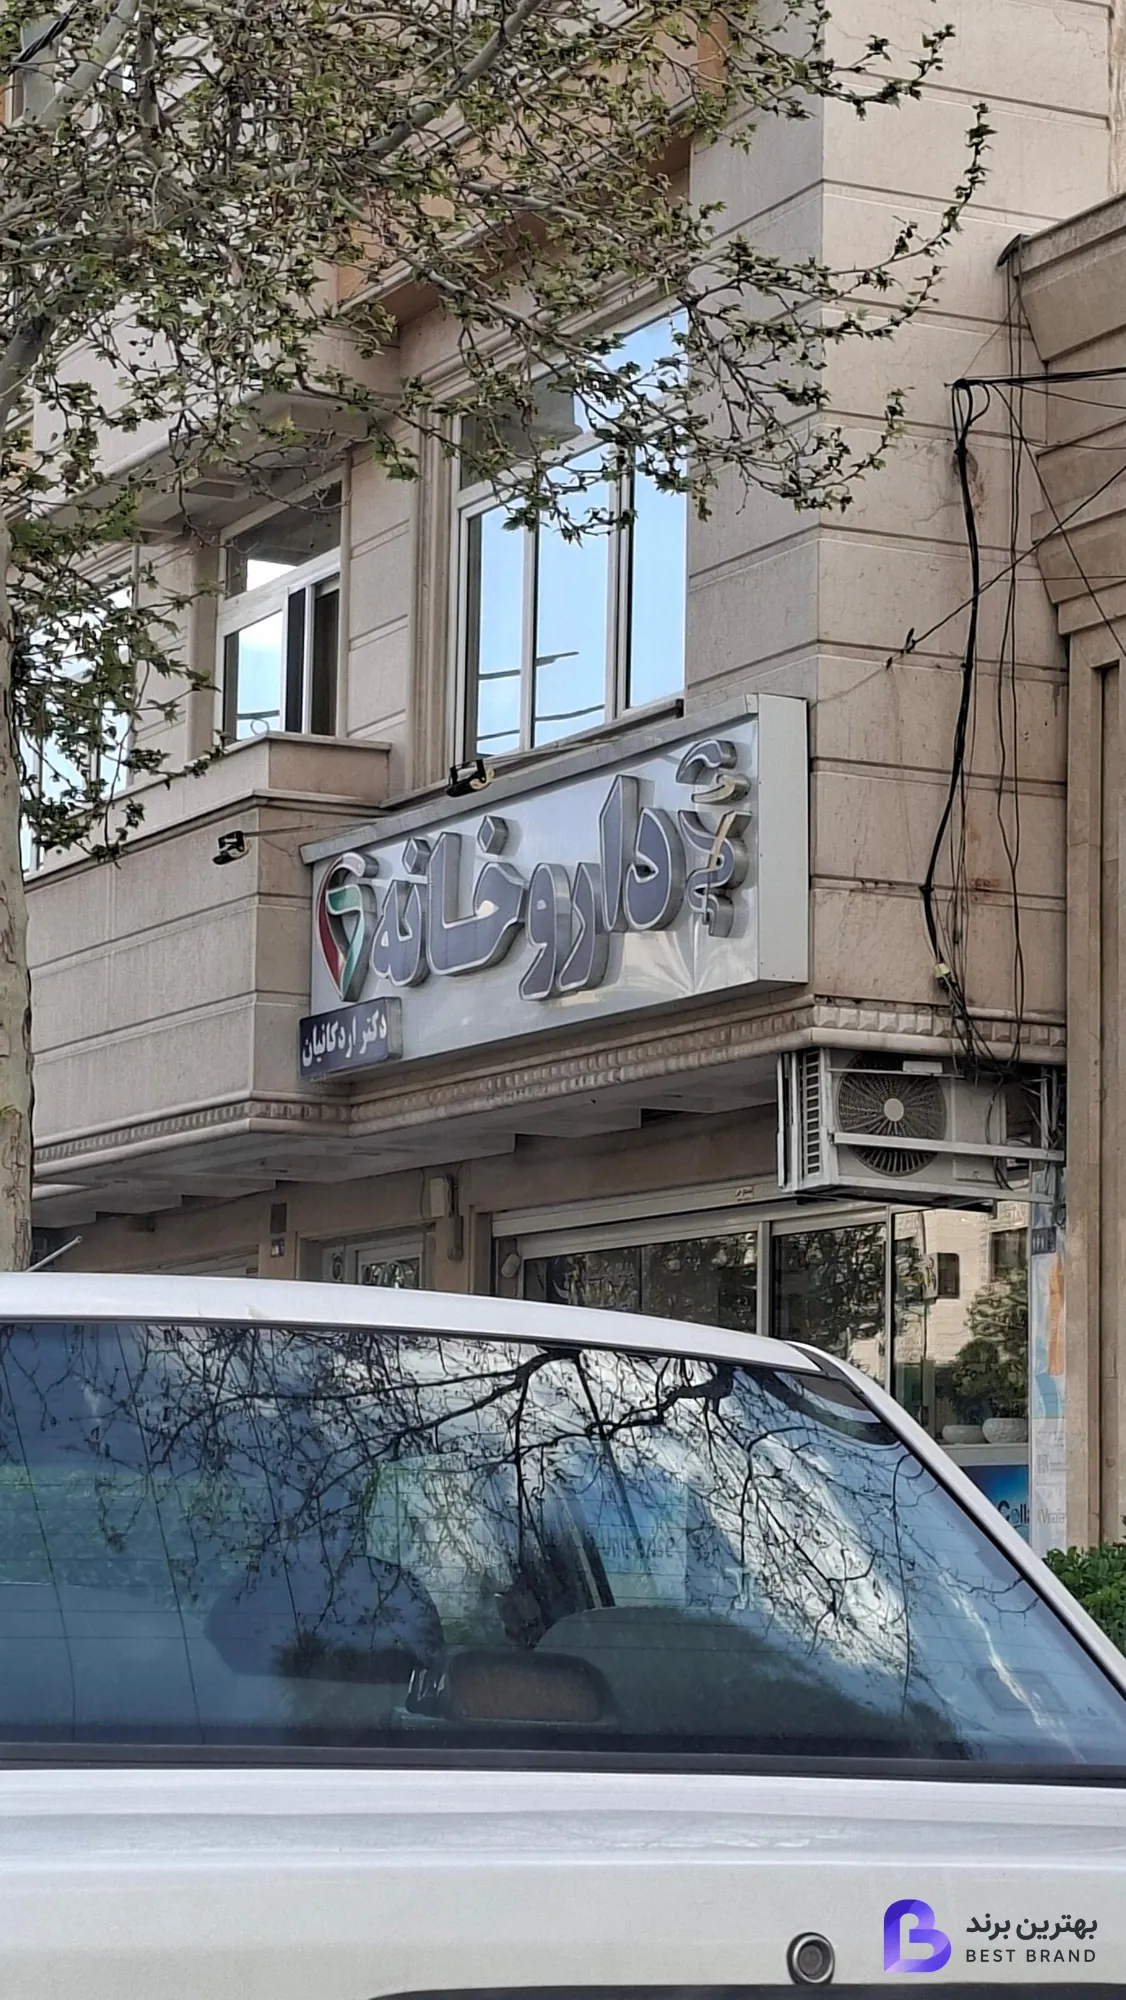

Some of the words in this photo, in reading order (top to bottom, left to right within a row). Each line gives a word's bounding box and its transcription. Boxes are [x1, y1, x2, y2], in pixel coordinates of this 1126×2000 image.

[371, 774, 686, 1001] داروخانه
[302, 1015, 357, 1068] اردکانیان
[358, 1008, 388, 1055] دکتر
